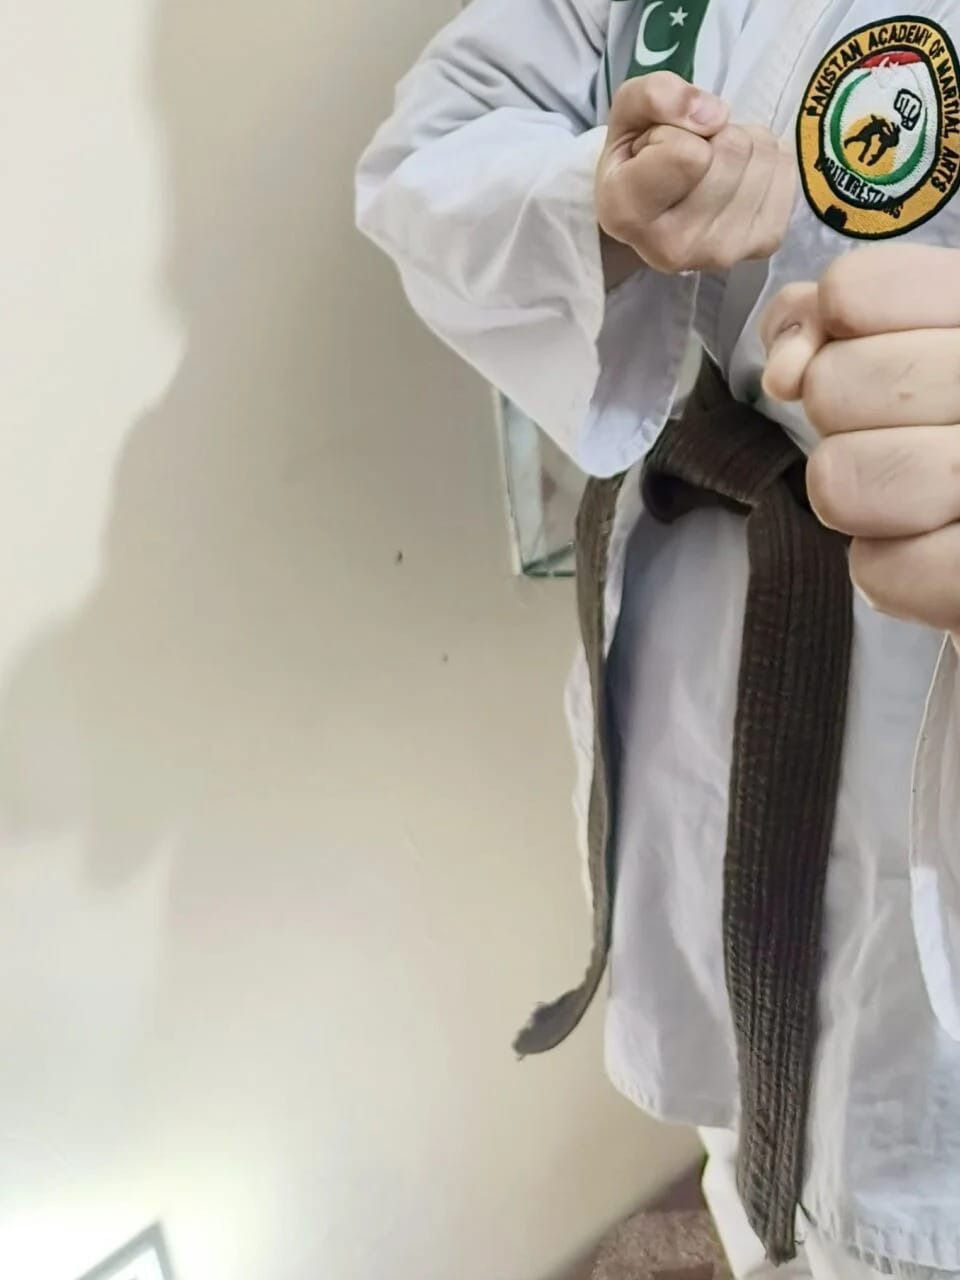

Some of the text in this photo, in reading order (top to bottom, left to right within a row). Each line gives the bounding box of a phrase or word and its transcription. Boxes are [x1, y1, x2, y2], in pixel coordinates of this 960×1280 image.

[868, 24, 934, 51] ACADEMY
[929, 38, 946, 60] OF
[804, 39, 865, 117] PAKISTAN
[930, 146, 960, 194] ARTS
